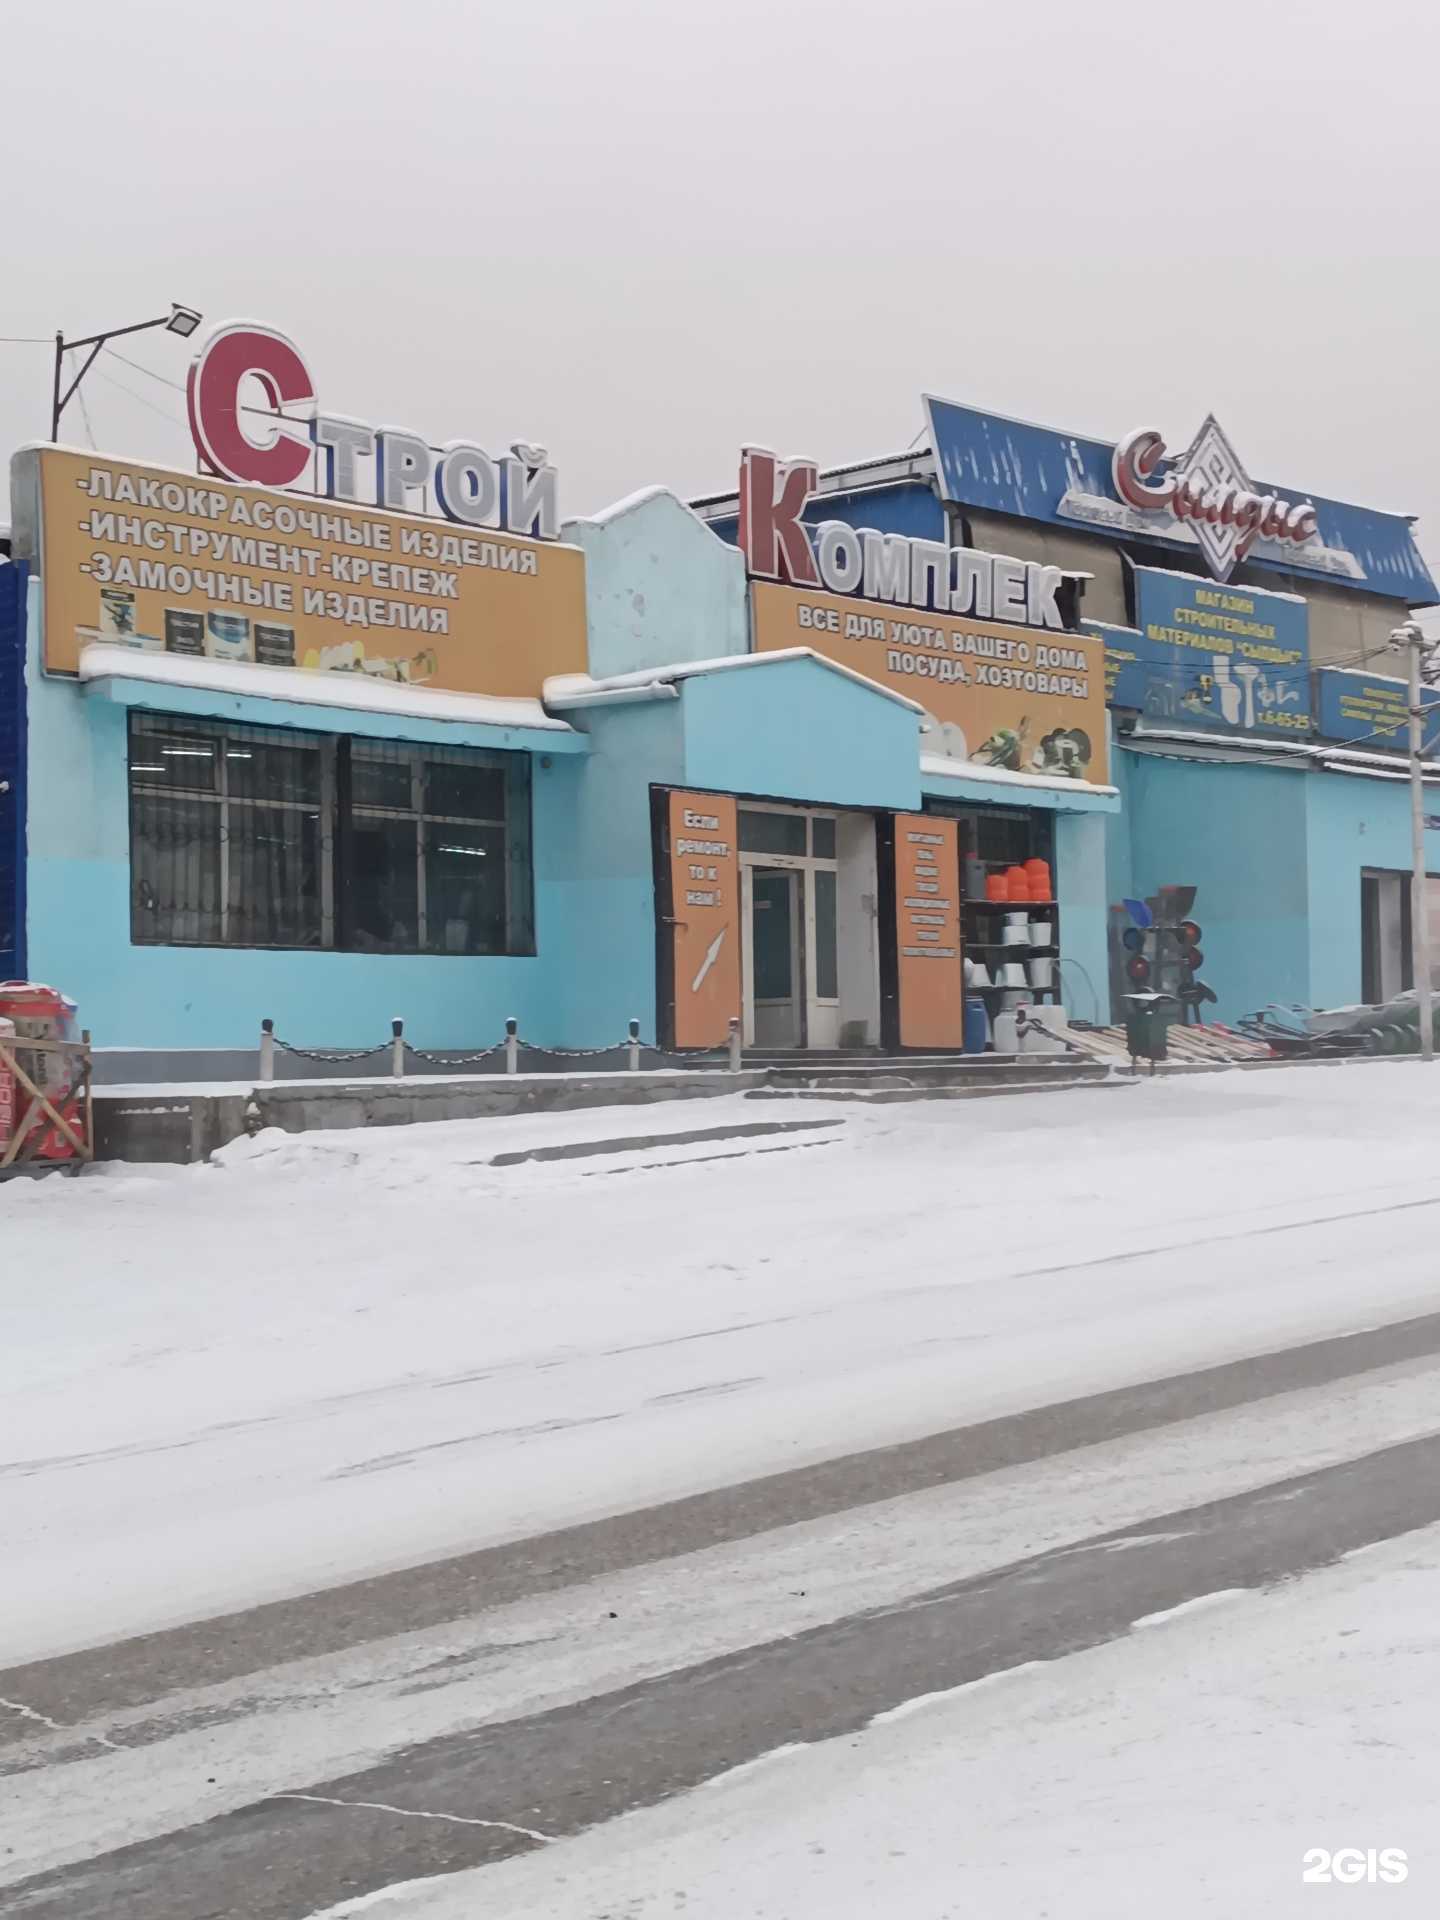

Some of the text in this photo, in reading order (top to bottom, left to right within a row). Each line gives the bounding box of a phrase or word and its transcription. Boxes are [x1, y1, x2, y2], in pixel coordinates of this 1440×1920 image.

[400, 527, 537, 575] ИЗДЕЛИЯ
[303, 587, 449, 634] ИЗДЕЛИЯ
[1195, 589, 1254, 614] МАГАЗИН
[798, 605, 840, 632] ВСЕ
[845, 612, 886, 640] ДЛЯ
[891, 622, 948, 650] УЮТА
[952, 632, 1029, 662] ВАШЕГО
[1036, 644, 1088, 671] ДОМА
[887, 651, 1088, 698] ПОСУДА, ХОЗТОВАРЫ
